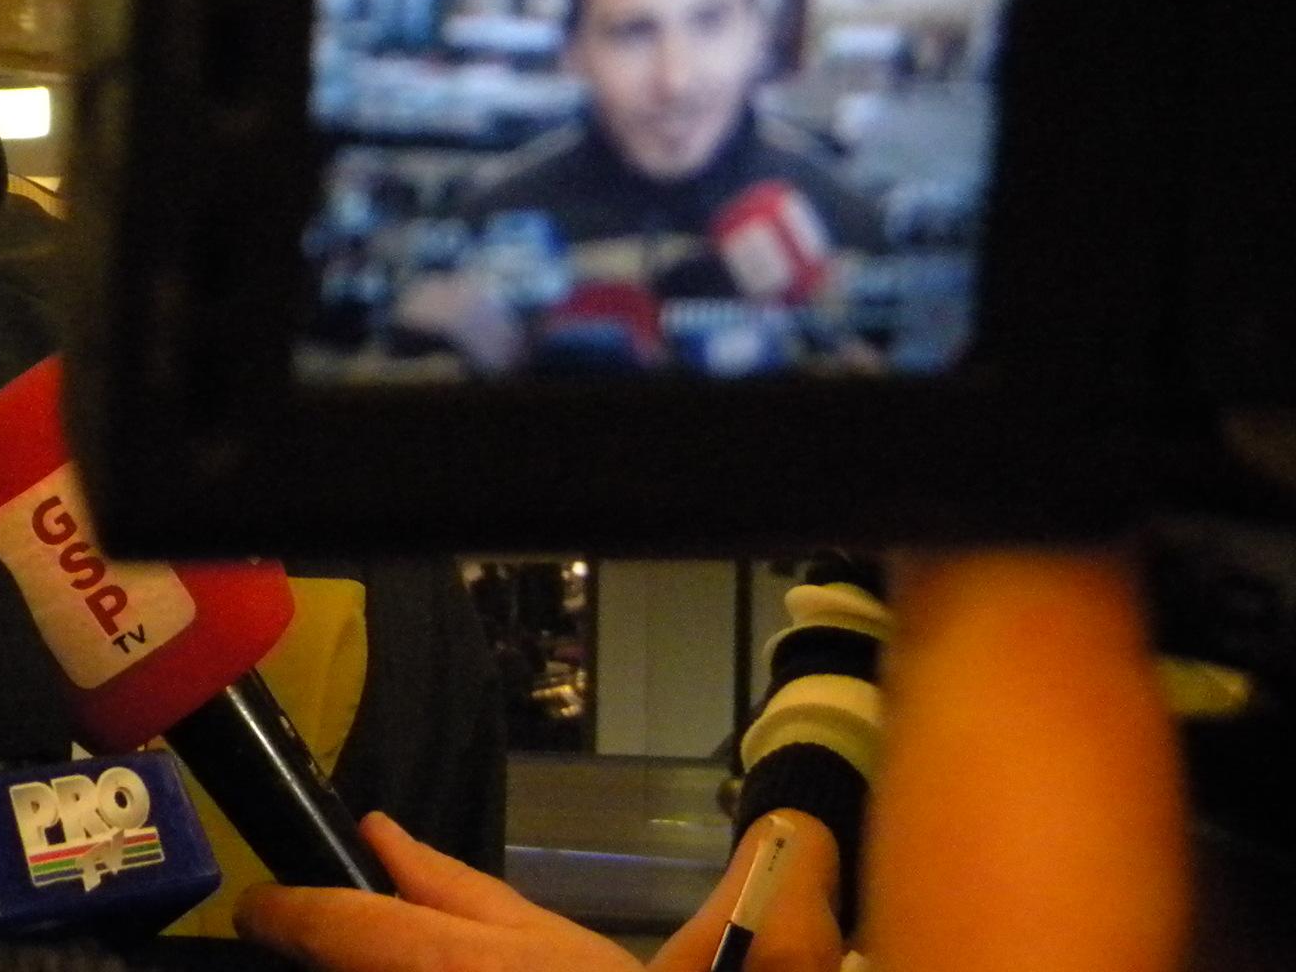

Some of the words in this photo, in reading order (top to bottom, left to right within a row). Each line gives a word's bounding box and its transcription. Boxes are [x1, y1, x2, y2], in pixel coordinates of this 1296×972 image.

[32, 495, 128, 637] GSP
[112, 623, 146, 654] TV
[9, 766, 150, 850] PRO
